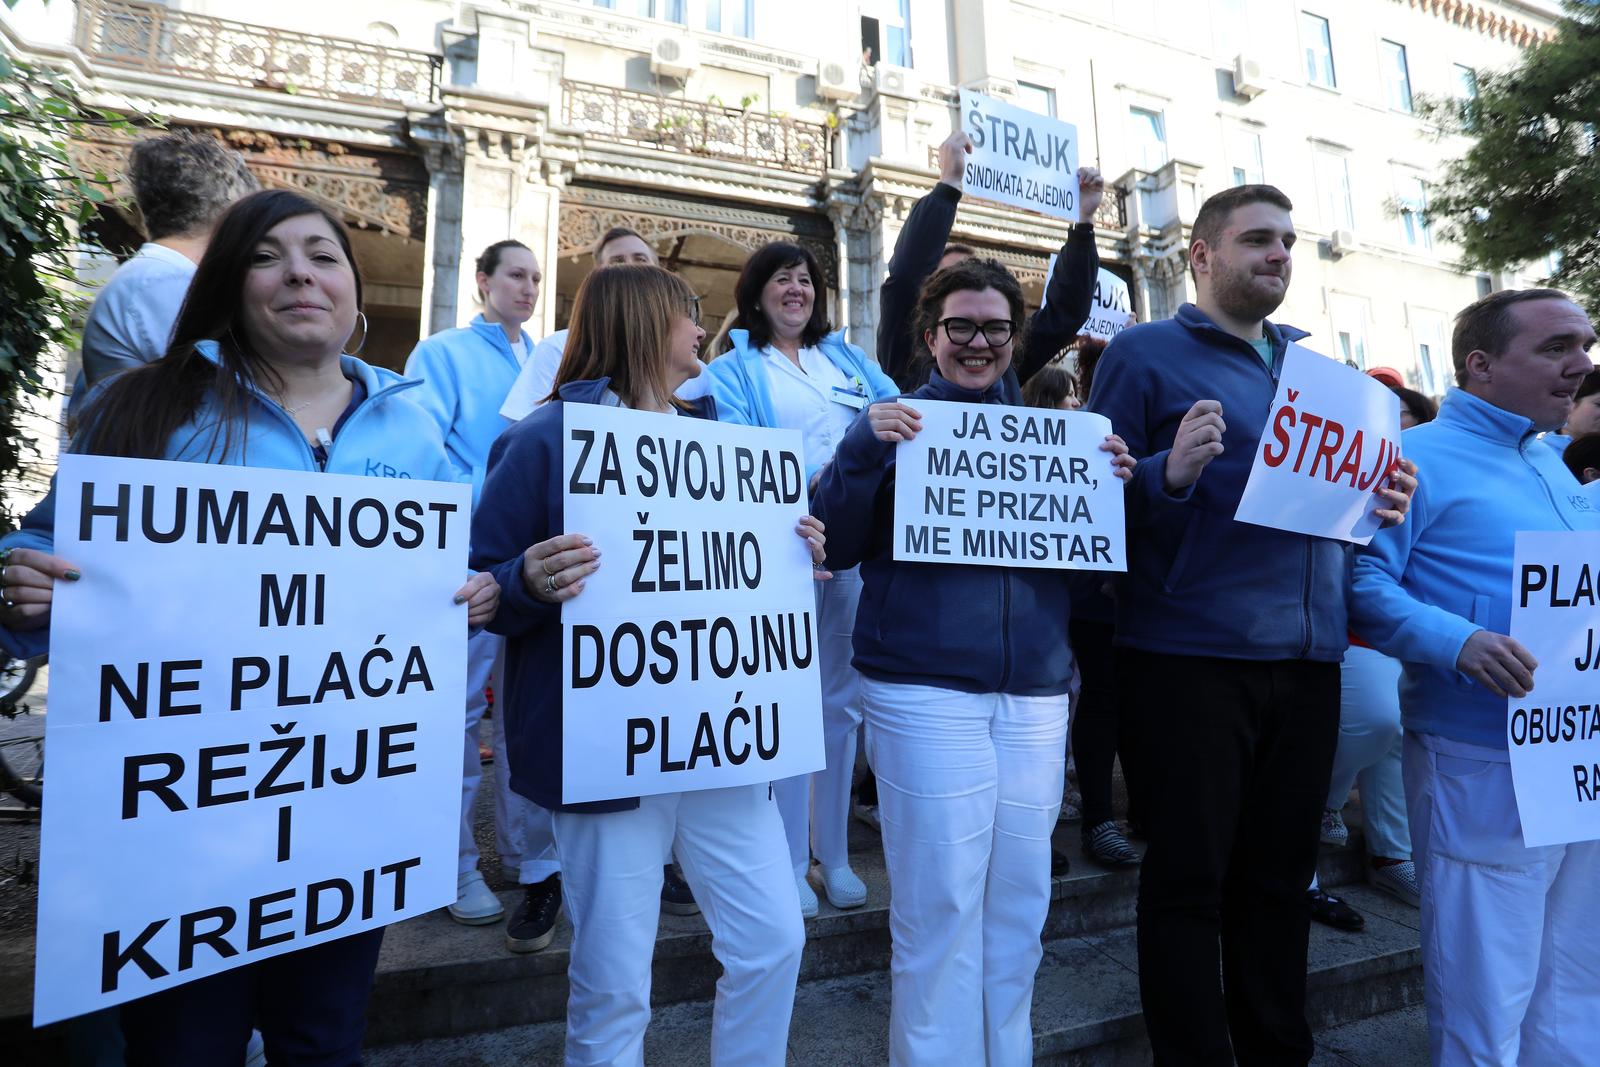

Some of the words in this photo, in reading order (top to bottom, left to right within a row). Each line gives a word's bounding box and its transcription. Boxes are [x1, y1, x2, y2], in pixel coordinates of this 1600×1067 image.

[968, 100, 1071, 175] ŠTRAJK
[966, 162, 1024, 198] SINDIKATA
[1026, 179, 1074, 211] ZAJEDNO
[1093, 281, 1126, 313] AJK
[952, 411, 992, 441] JA
[1000, 414, 1066, 446] SAM
[1263, 388, 1401, 493] ŠTRAJK
[569, 429, 626, 496] ZA
[636, 434, 726, 502] SVOJ
[735, 447, 801, 505] RAD
[927, 447, 1098, 491] MAGISTAR,
[78, 482, 458, 550] HUMANOST
[924, 486, 966, 517] NE
[977, 490, 1093, 524] PRIZNA
[631, 511, 762, 593] ŽELIMO
[905, 525, 952, 555] ME
[962, 528, 1113, 564] MINISTAR
[259, 573, 326, 628] MI
[1520, 563, 1600, 608] PLA
[98, 659, 203, 723] NE
[230, 634, 435, 711] PLAĆA
[571, 611, 813, 689] DOSTOJNU
[626, 691, 780, 776] PLAĆU
[121, 721, 418, 820] REŽIJE
[277, 805, 292, 863] I
[100, 856, 422, 995] KREDIT
